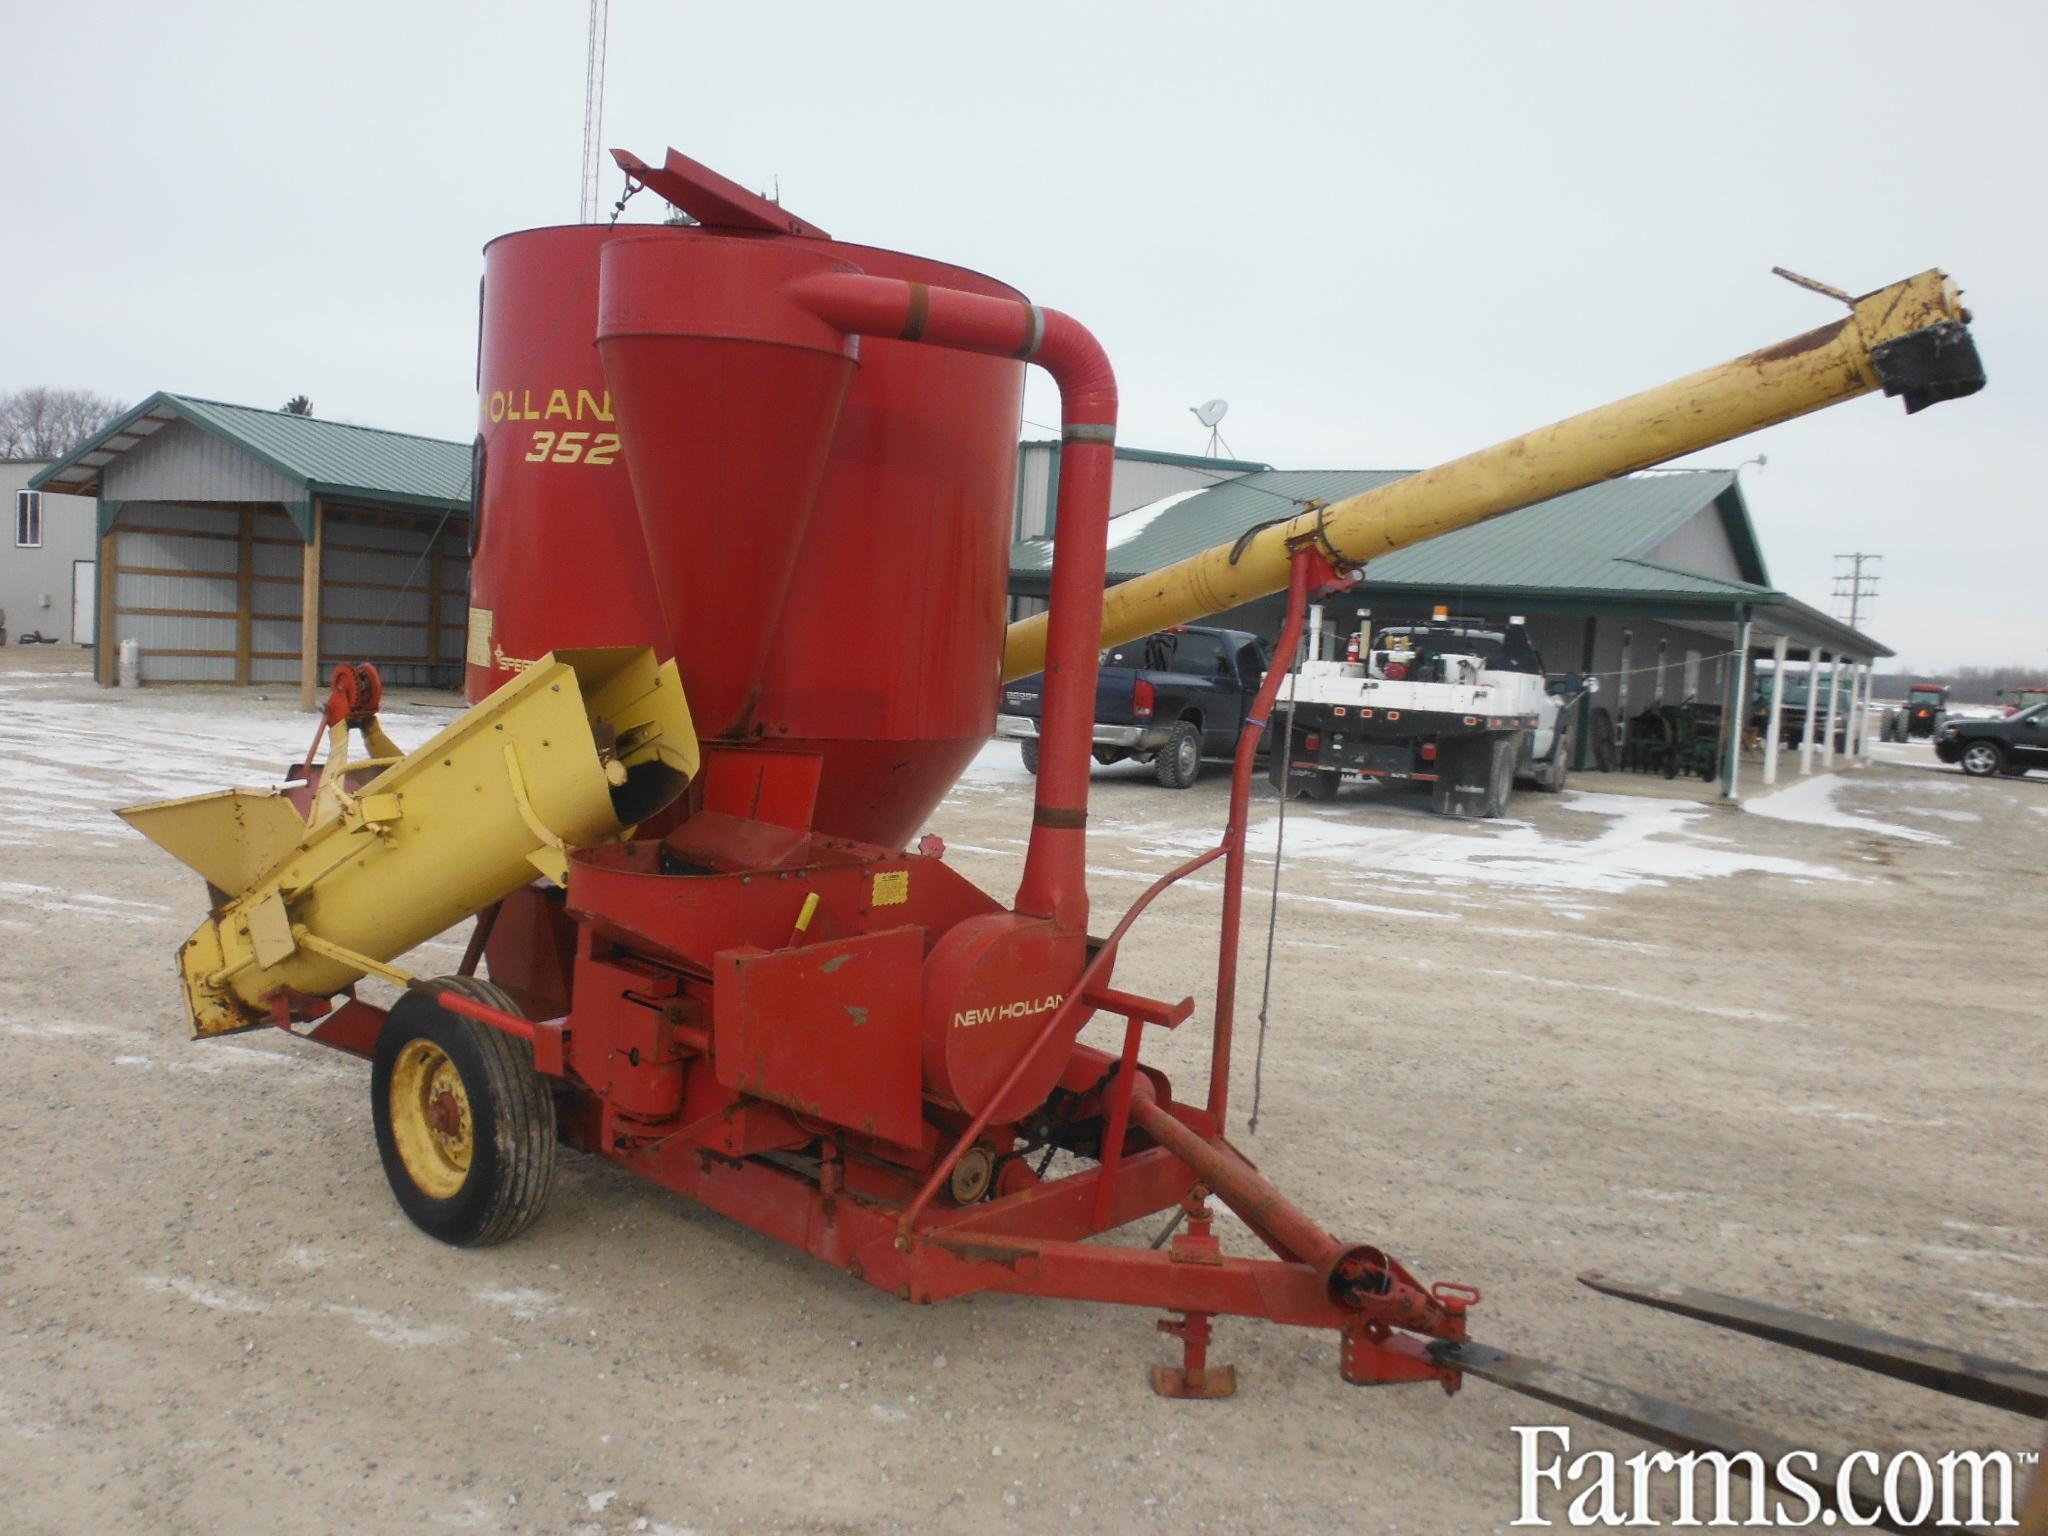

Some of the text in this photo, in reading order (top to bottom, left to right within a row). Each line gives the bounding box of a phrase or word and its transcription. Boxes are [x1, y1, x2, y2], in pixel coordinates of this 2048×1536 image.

[525, 431, 622, 465] 352
[954, 993, 1066, 1028] NEW HOLLAN
